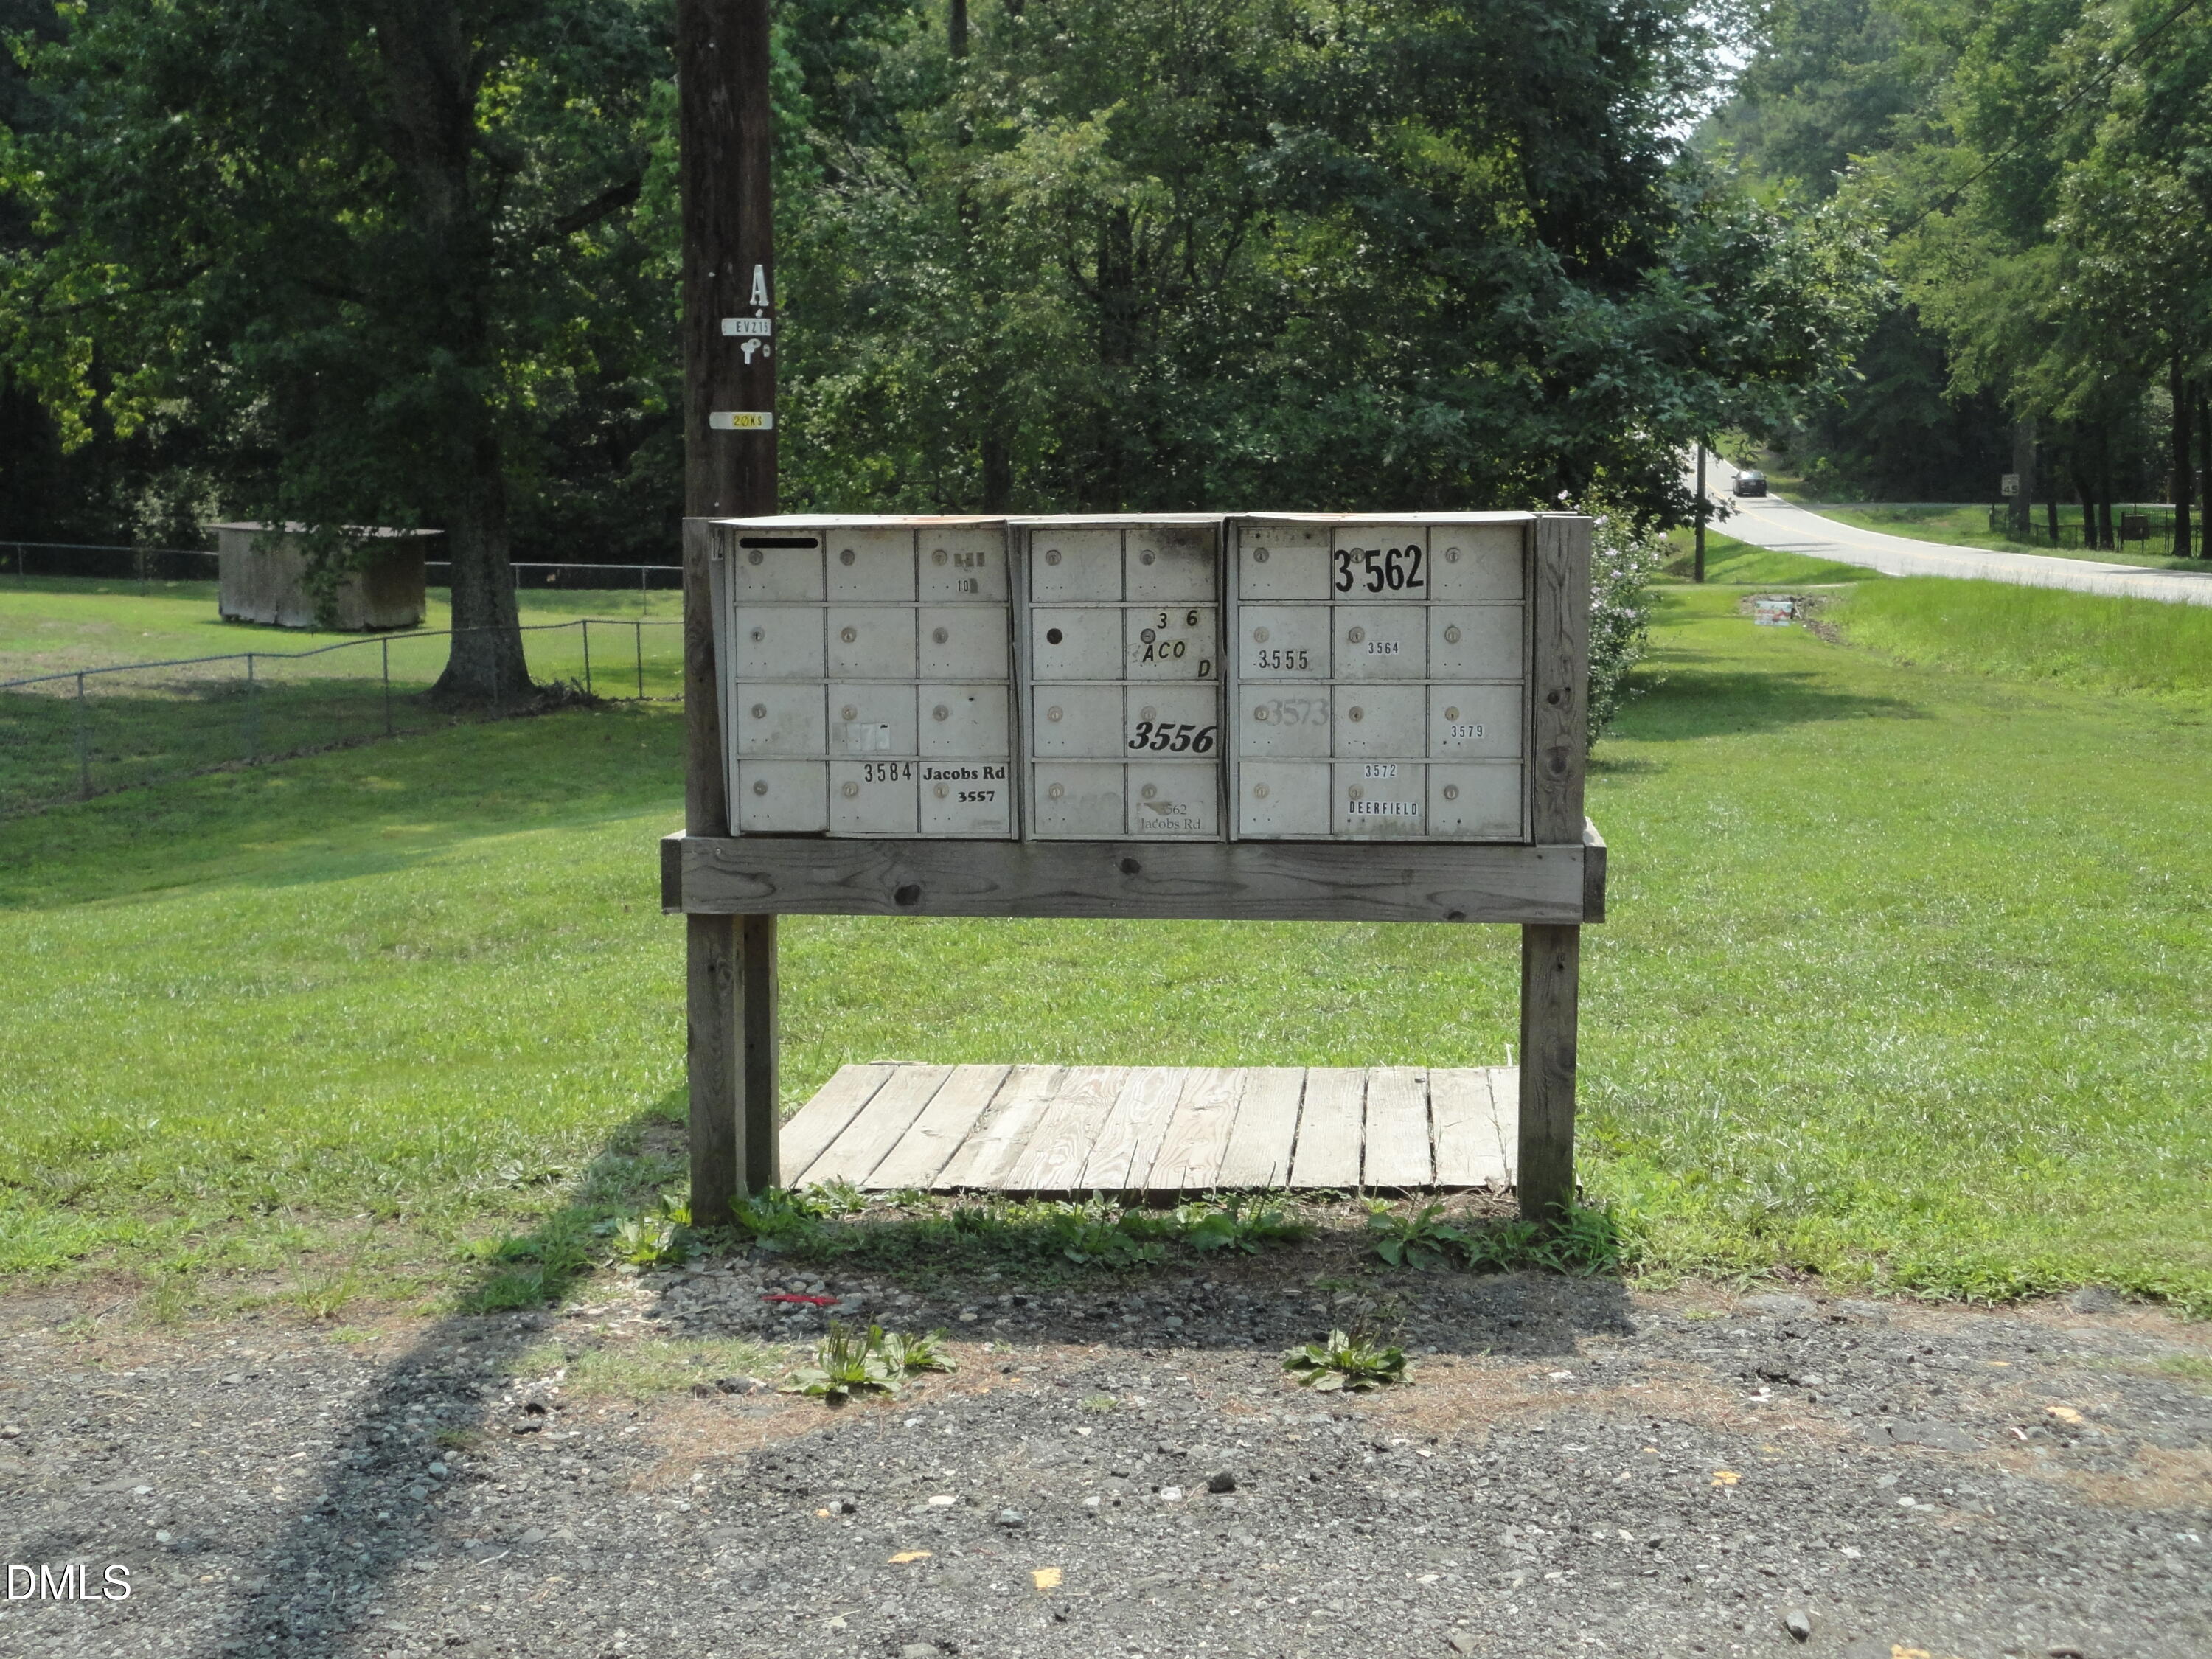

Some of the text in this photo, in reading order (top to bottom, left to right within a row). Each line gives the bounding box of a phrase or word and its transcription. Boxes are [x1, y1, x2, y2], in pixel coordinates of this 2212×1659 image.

[749, 264, 769, 306] A
[1334, 544, 1424, 593] 3562
[1368, 642, 1399, 654] 3564
[1259, 650, 1307, 669] 3555
[1266, 698, 1329, 726] 3573
[1128, 721, 1217, 754] 3556
[1451, 725, 1484, 737] 3579
[864, 762, 912, 782] 3584
[923, 766, 1006, 780] Jacobs Rd
[1366, 764, 1397, 777] 3572
[958, 790, 995, 802] 3557
[1349, 801, 1418, 815] DEERFIELD
